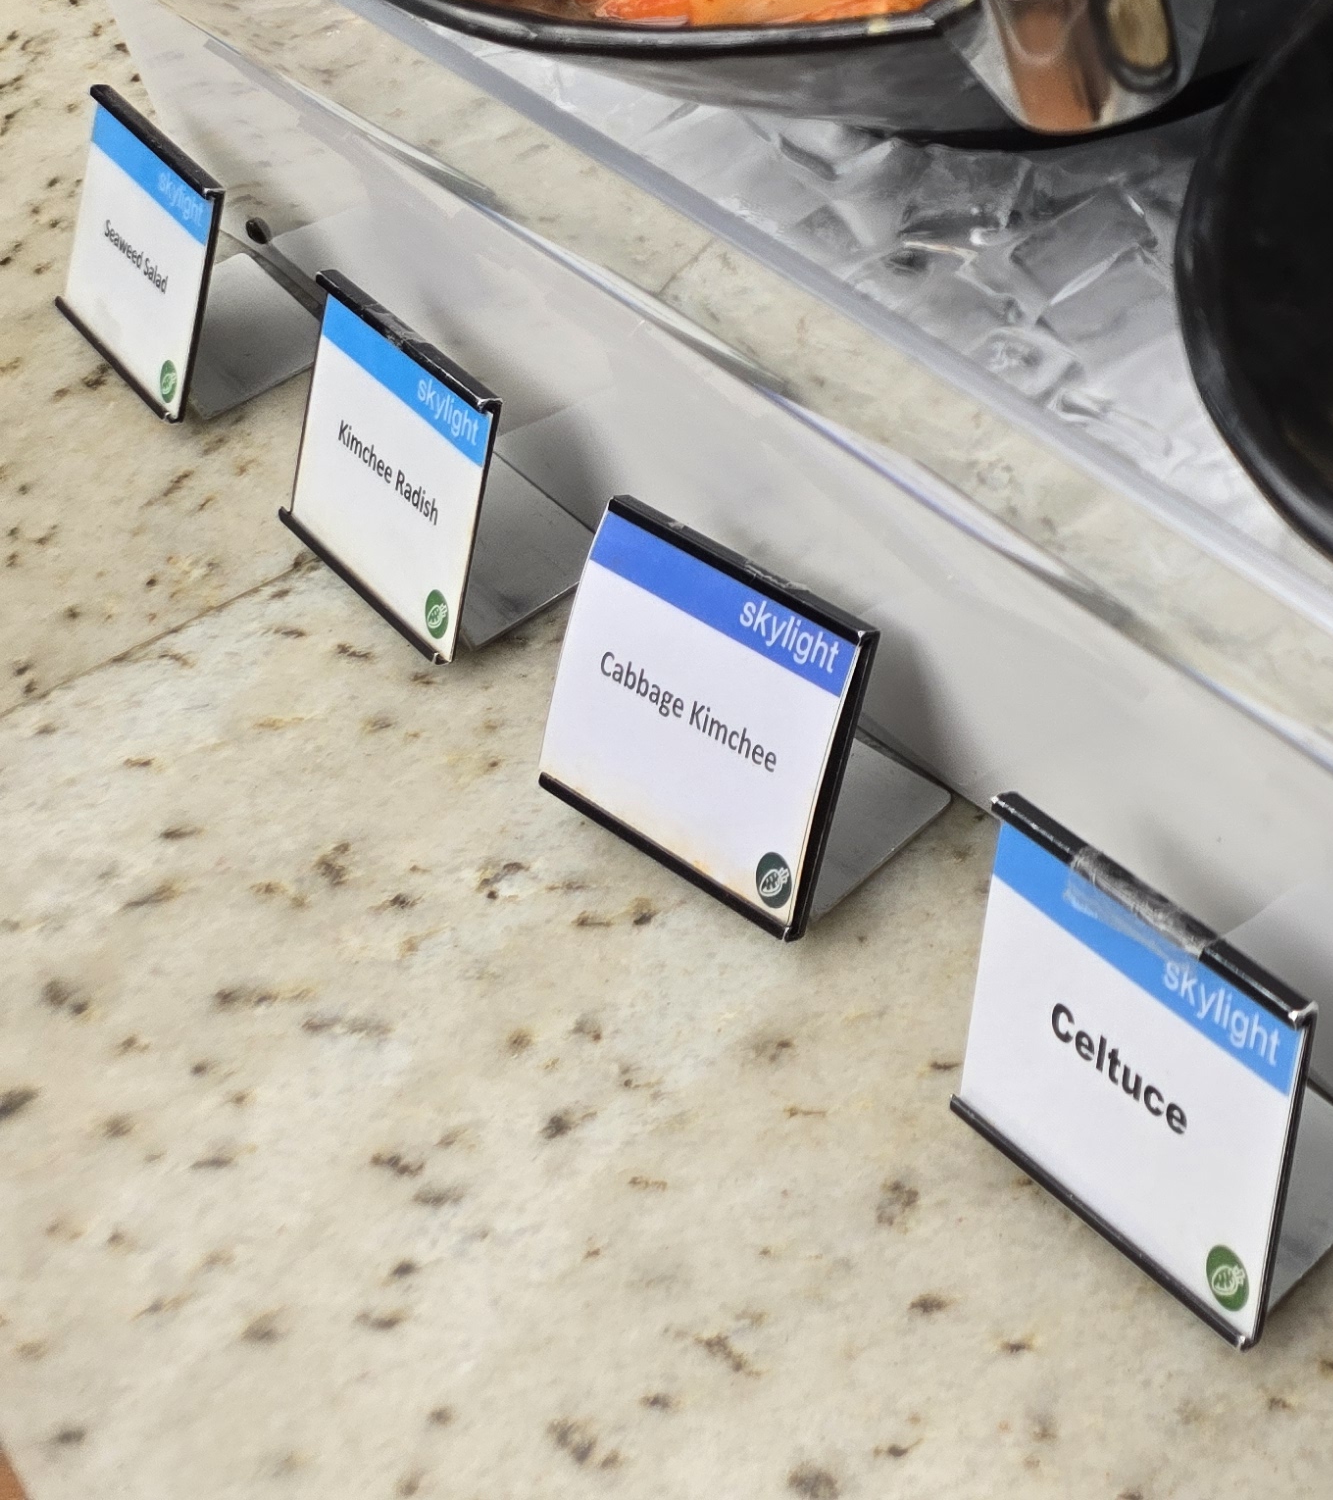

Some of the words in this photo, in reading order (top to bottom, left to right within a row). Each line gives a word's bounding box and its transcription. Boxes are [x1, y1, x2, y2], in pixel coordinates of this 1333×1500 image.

[158, 172, 204, 226] skylight
[104, 219, 144, 270] Seaweed
[143, 257, 169, 294] Salad
[417, 378, 479, 446] skylight
[338, 419, 393, 484] Kimchee
[395, 469, 439, 526] Radish
[739, 600, 839, 673] skylight
[600, 650, 684, 718] Cabbage
[688, 700, 778, 773] Kimchee
[1162, 961, 1280, 1067] skylight
[1051, 1003, 1188, 1134] Celtuce
